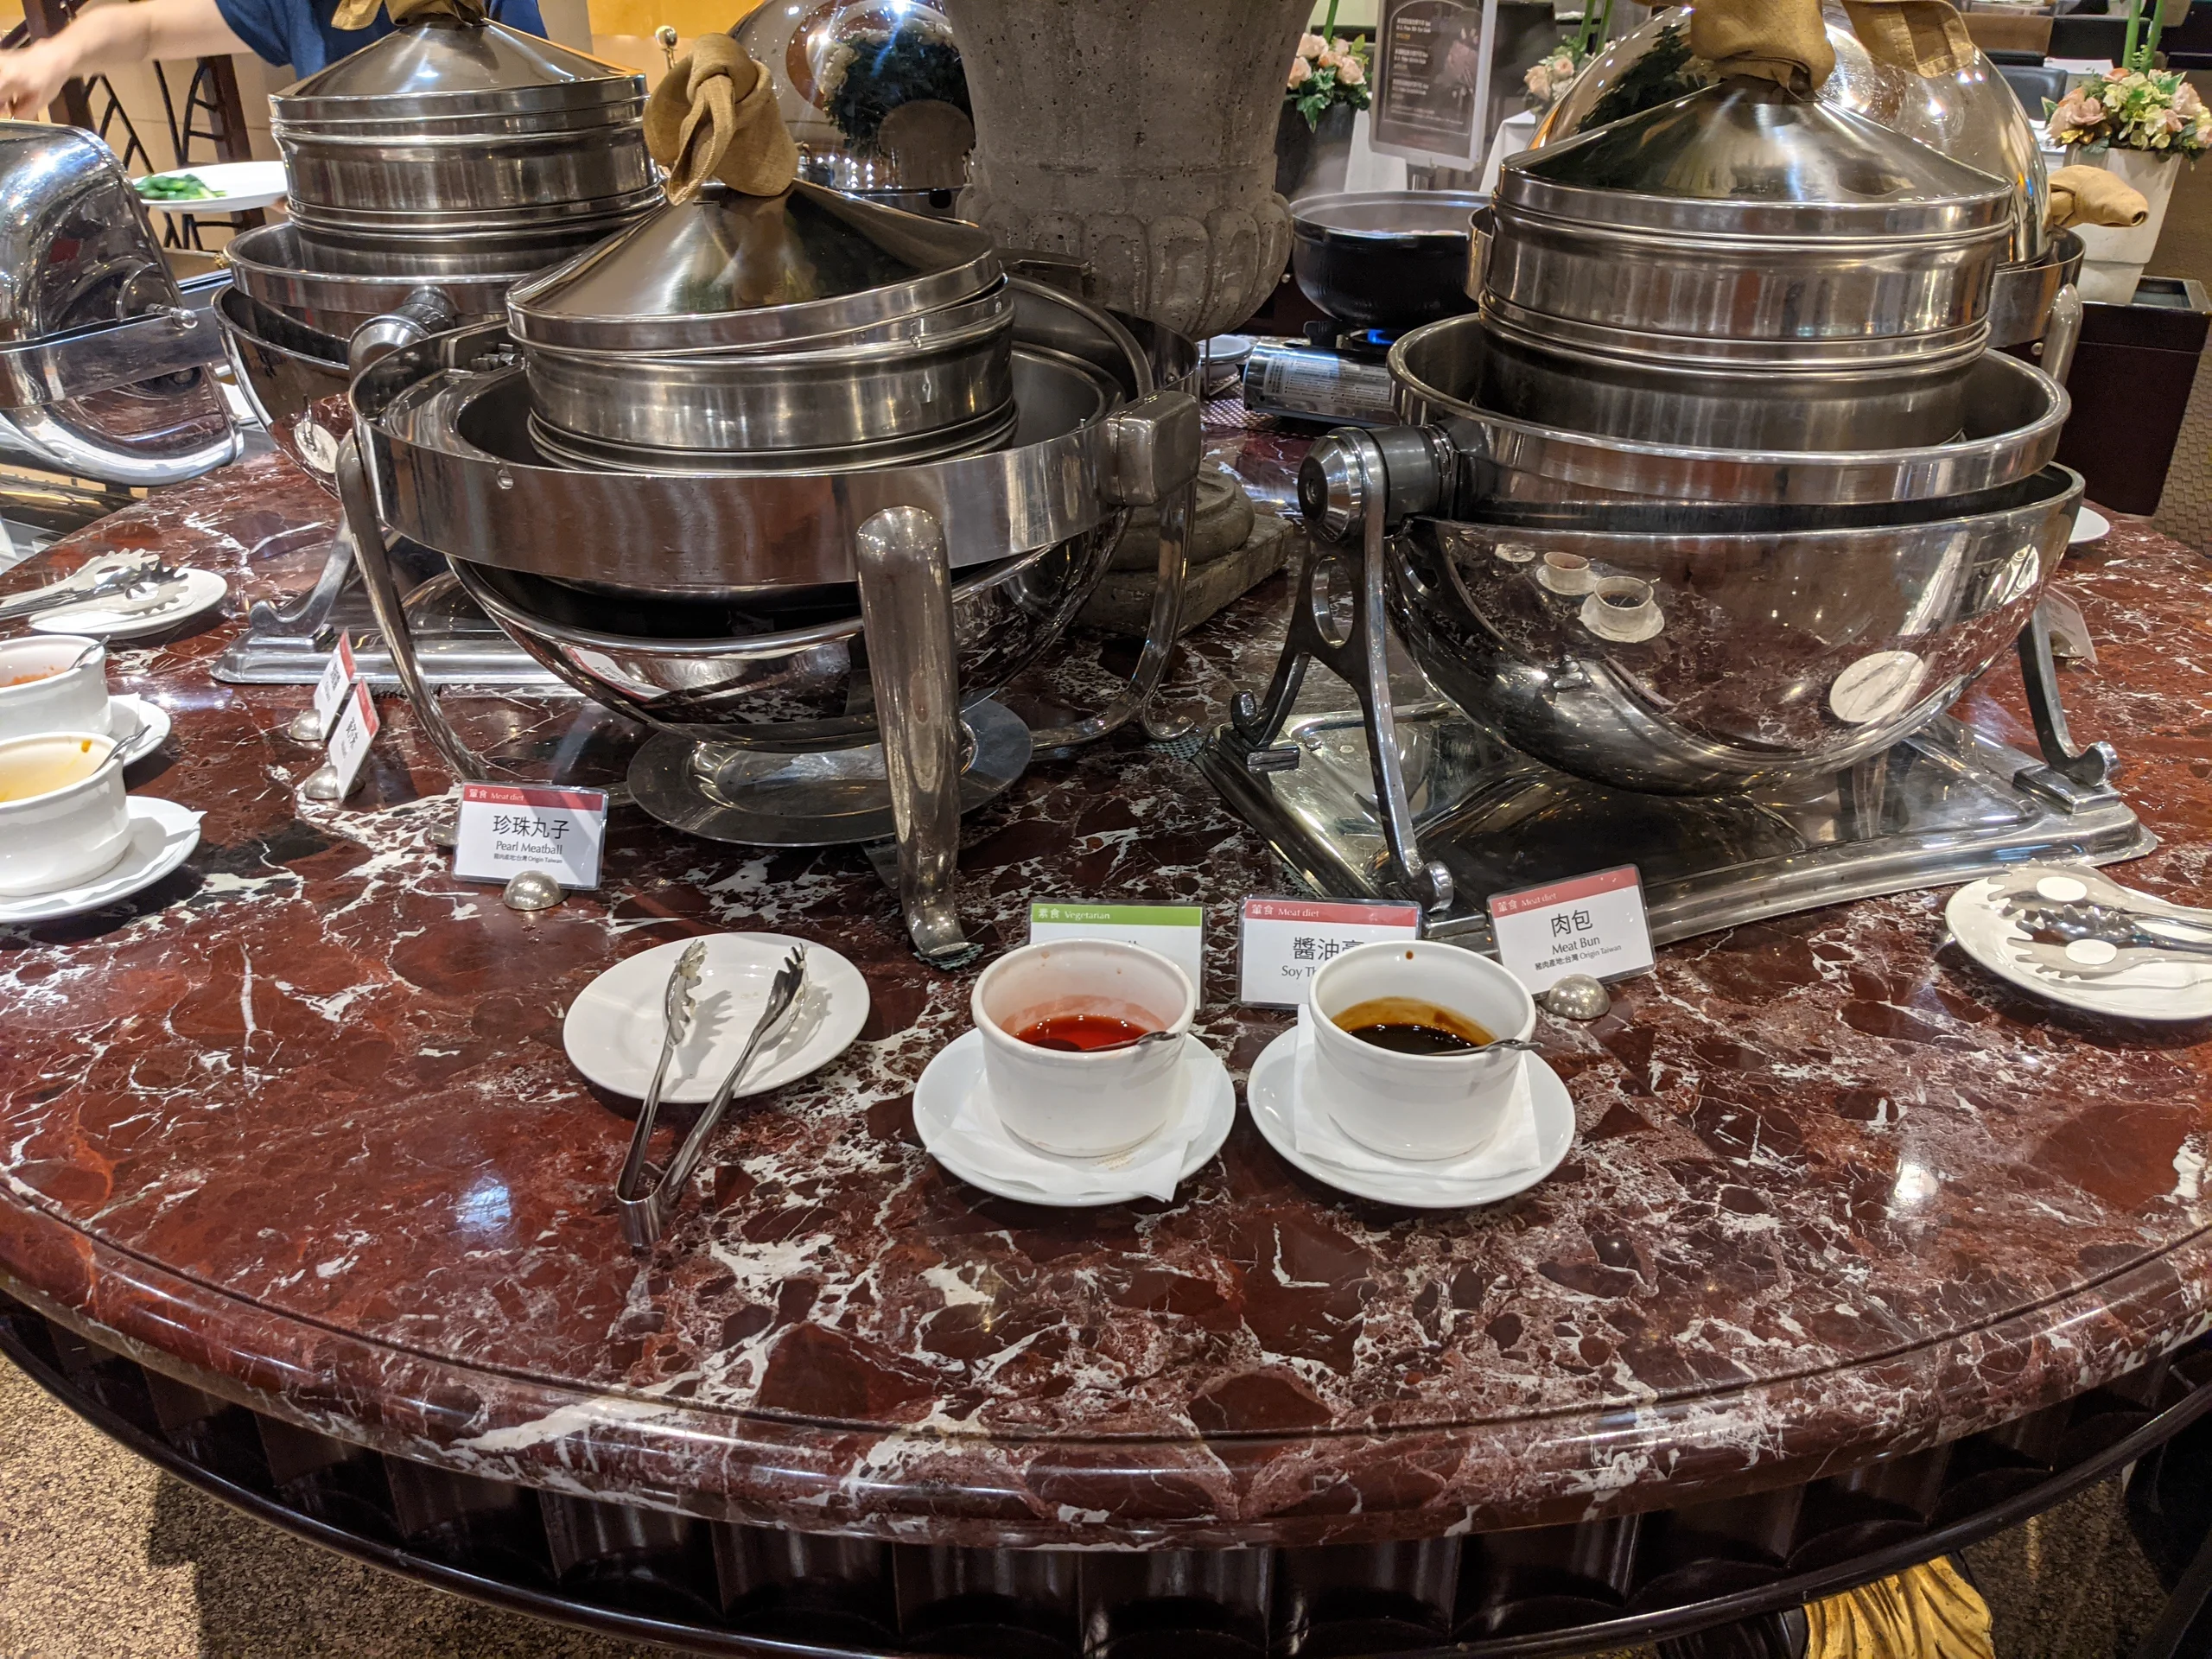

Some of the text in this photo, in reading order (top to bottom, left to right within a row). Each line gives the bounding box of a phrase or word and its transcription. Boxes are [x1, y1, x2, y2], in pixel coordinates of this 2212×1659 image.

[491, 791, 509, 800] Meat
[510, 792, 524, 801] diet
[492, 815, 570, 840] 珍珠丸子
[496, 840, 563, 855] Pearl Meatball
[1521, 898, 1541, 907] Meat
[1541, 893, 1557, 902] diet
[1038, 907, 1110, 921] 素食 Vegetarian
[1278, 908, 1300, 917] Meat
[1302, 909, 1319, 918] diet
[1551, 909, 1593, 938] 肉包
[1552, 937, 1600, 955] Meat Bun
[1580, 950, 1599, 959] Origin
[1600, 945, 1622, 954] Taiwan
[1281, 965, 1303, 980] Soy
